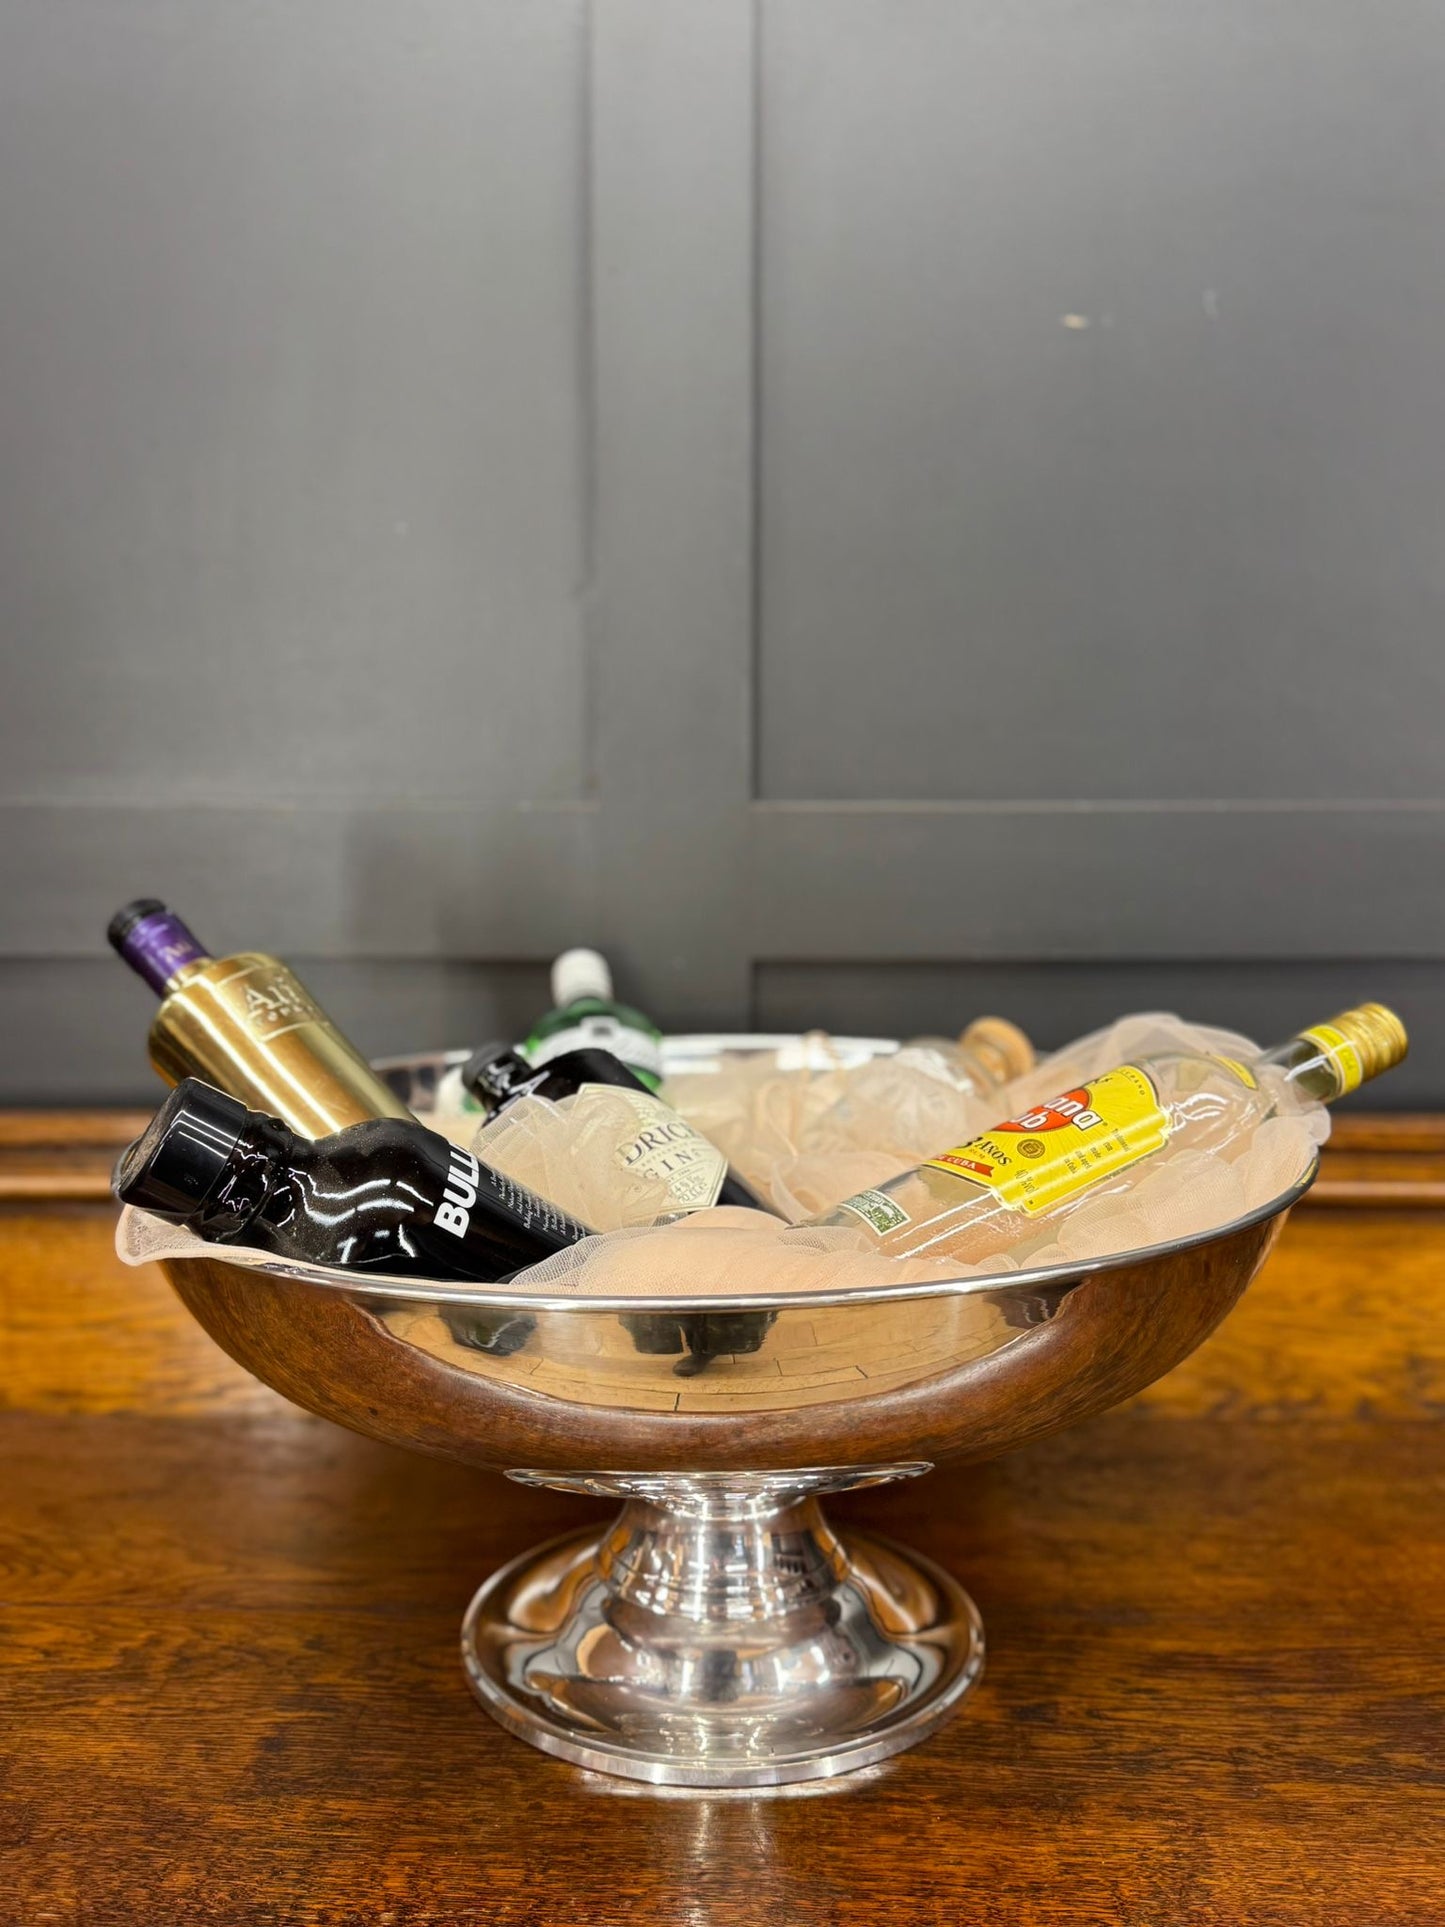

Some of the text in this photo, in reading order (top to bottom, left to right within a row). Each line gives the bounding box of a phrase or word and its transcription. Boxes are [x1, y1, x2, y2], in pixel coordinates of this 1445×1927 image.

[643, 1151, 694, 1181] GIN
[946, 1155, 977, 1170] CUBA
[433, 1142, 480, 1239] BULL
